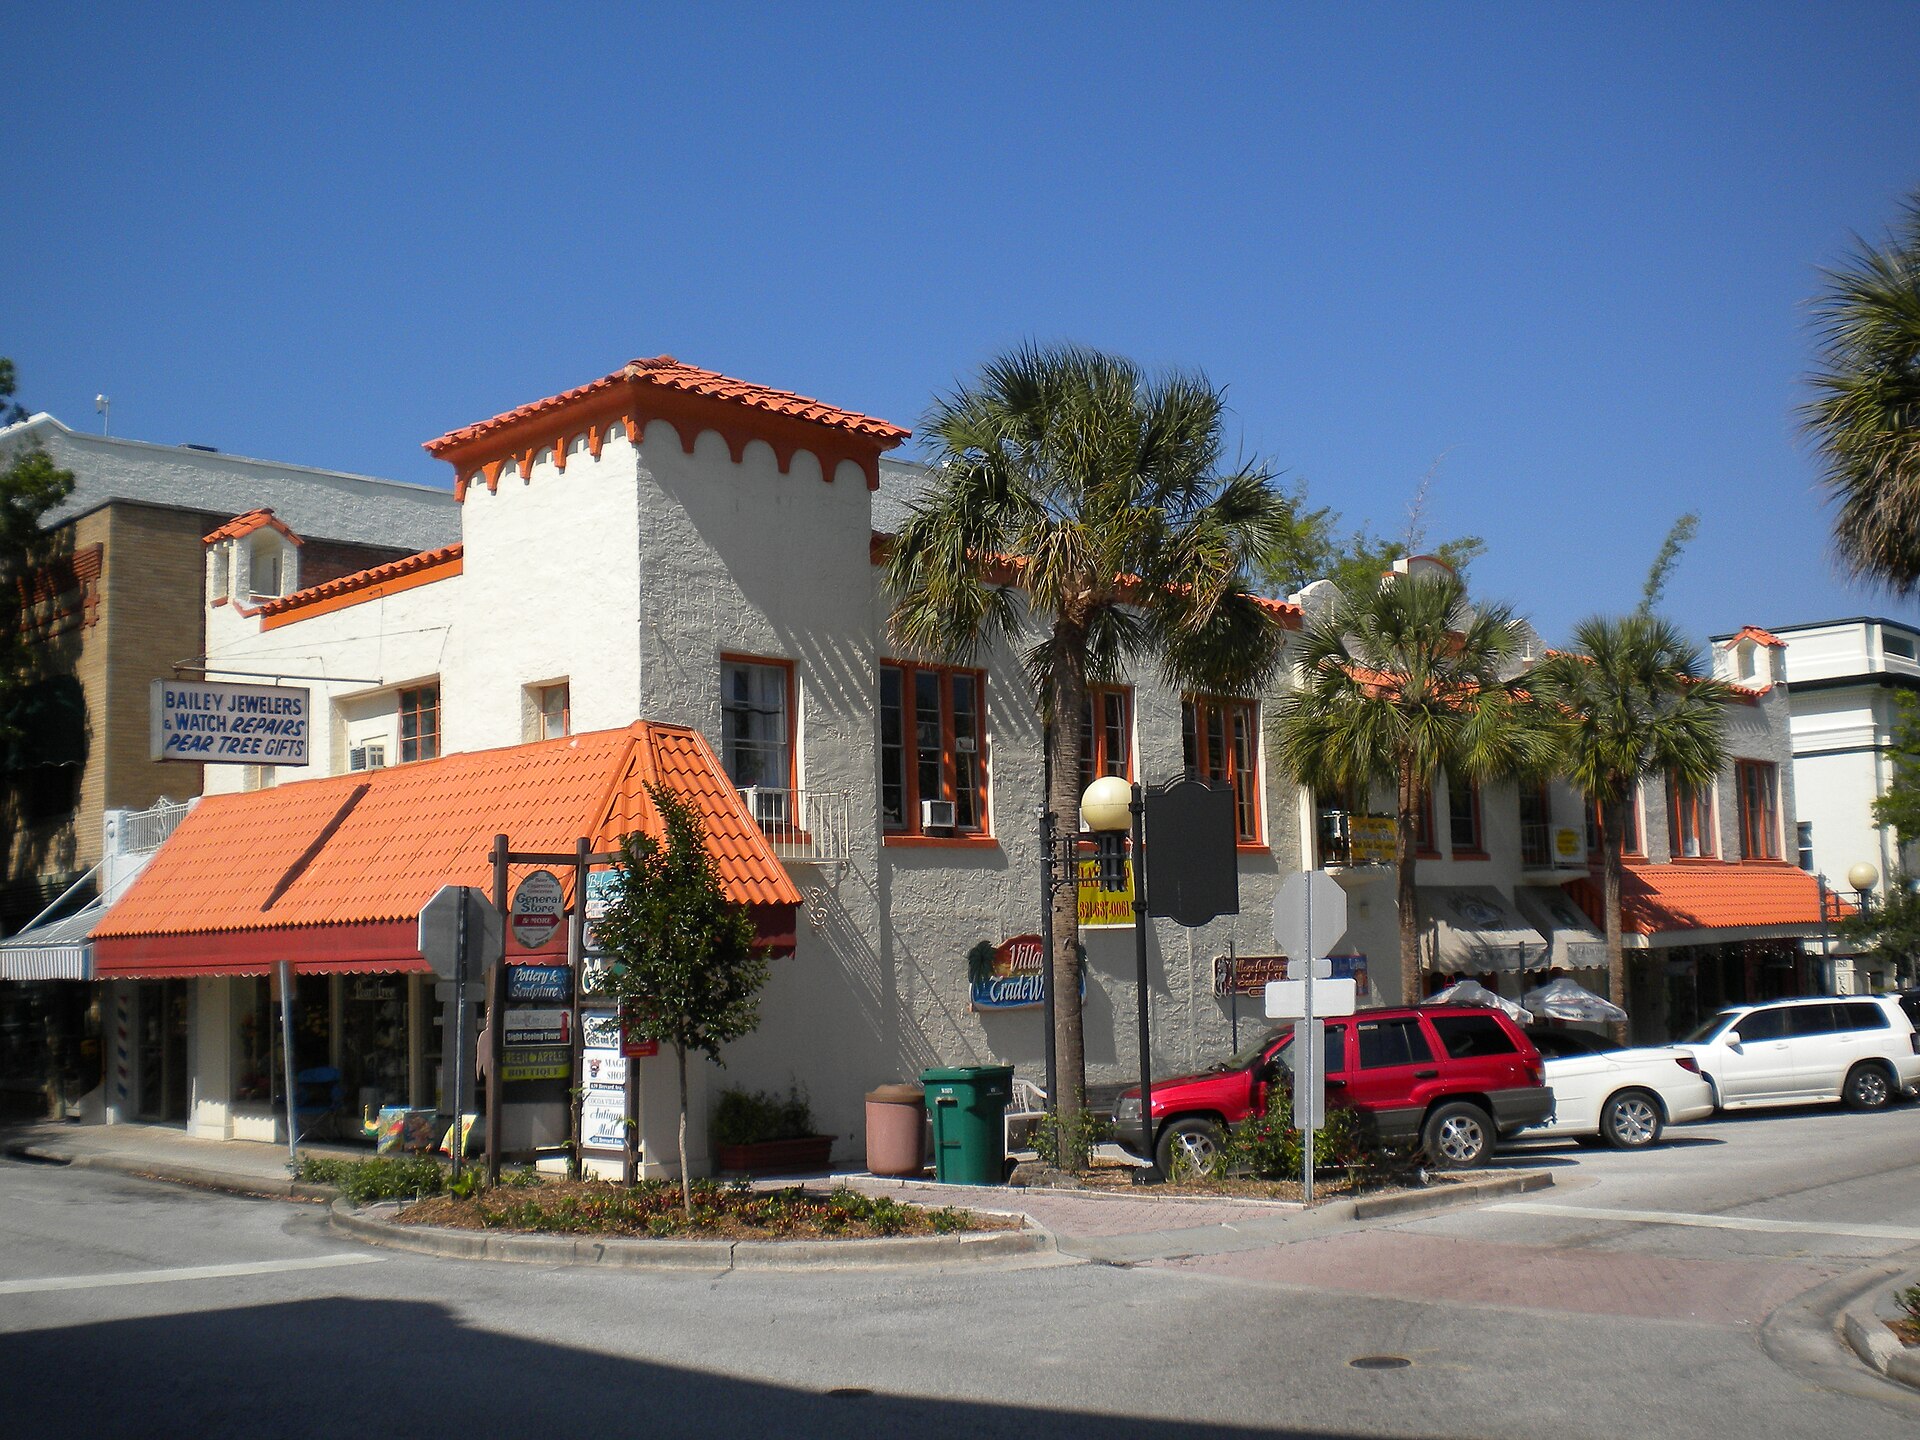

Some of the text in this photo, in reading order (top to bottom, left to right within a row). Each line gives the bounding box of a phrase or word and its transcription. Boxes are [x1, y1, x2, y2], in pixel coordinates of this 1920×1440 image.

[165, 690, 302, 715] BAILEY JEWELERS
[175, 713, 226, 732] WATCH
[230, 717, 305, 736] REPAIRS
[165, 733, 304, 756] PEAR TREE GIFTS
[516, 892, 562, 904] General
[521, 902, 554, 913] Store
[1079, 900, 1130, 919] 321-637-0061
[513, 968, 550, 985] Pottery
[511, 983, 559, 1000] Sculpture
[508, 1068, 559, 1077] BOUTIQUE
[597, 1123, 616, 1136] Mall
